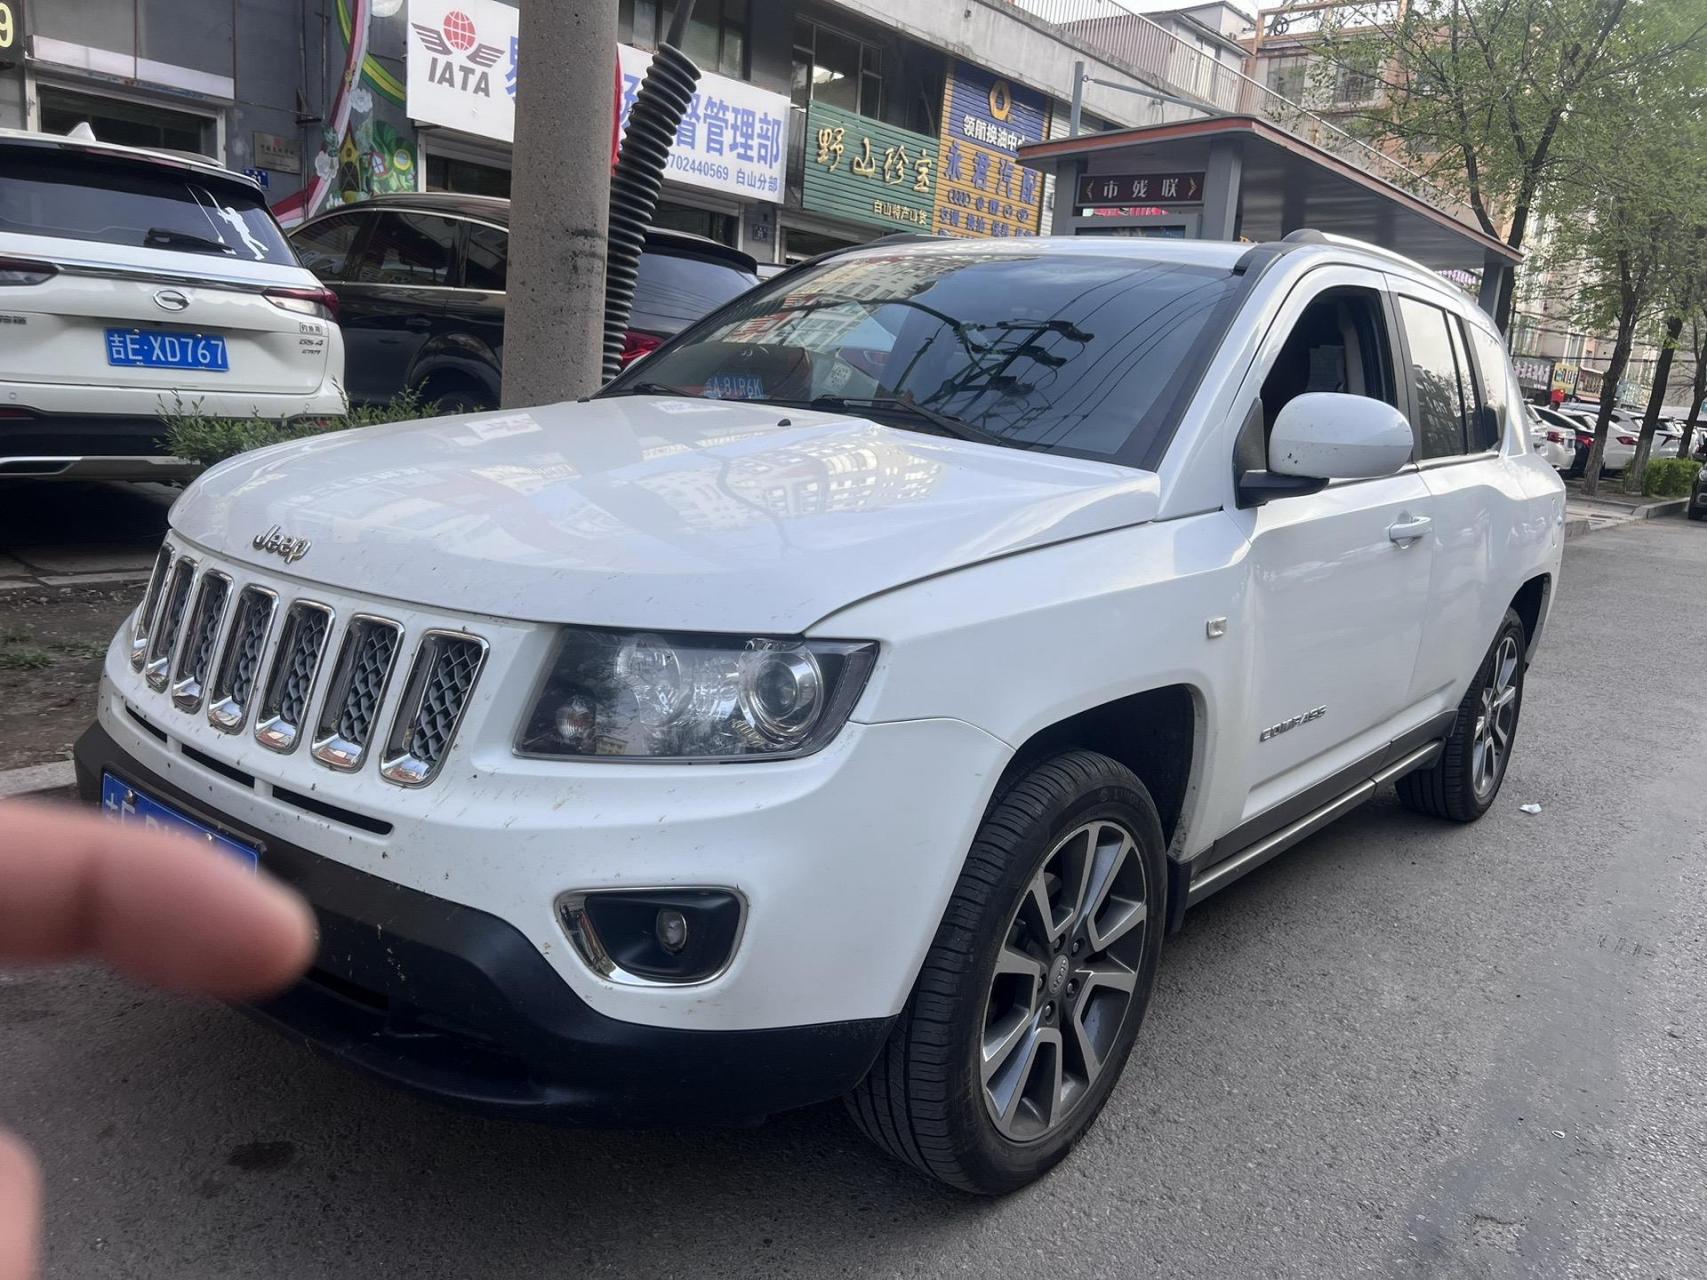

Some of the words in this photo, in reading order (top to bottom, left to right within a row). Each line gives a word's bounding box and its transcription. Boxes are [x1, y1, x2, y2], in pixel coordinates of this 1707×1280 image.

[428, 57, 491, 98] IATA
[667, 153, 729, 181] 702440569
[736, 168, 778, 192] 白山分部
[817, 127, 932, 193] 野山珍宝
[1103, 178, 1179, 198] 市残联
[109, 333, 223, 365] 吉E·XD767
[252, 525, 312, 563] Jeep
